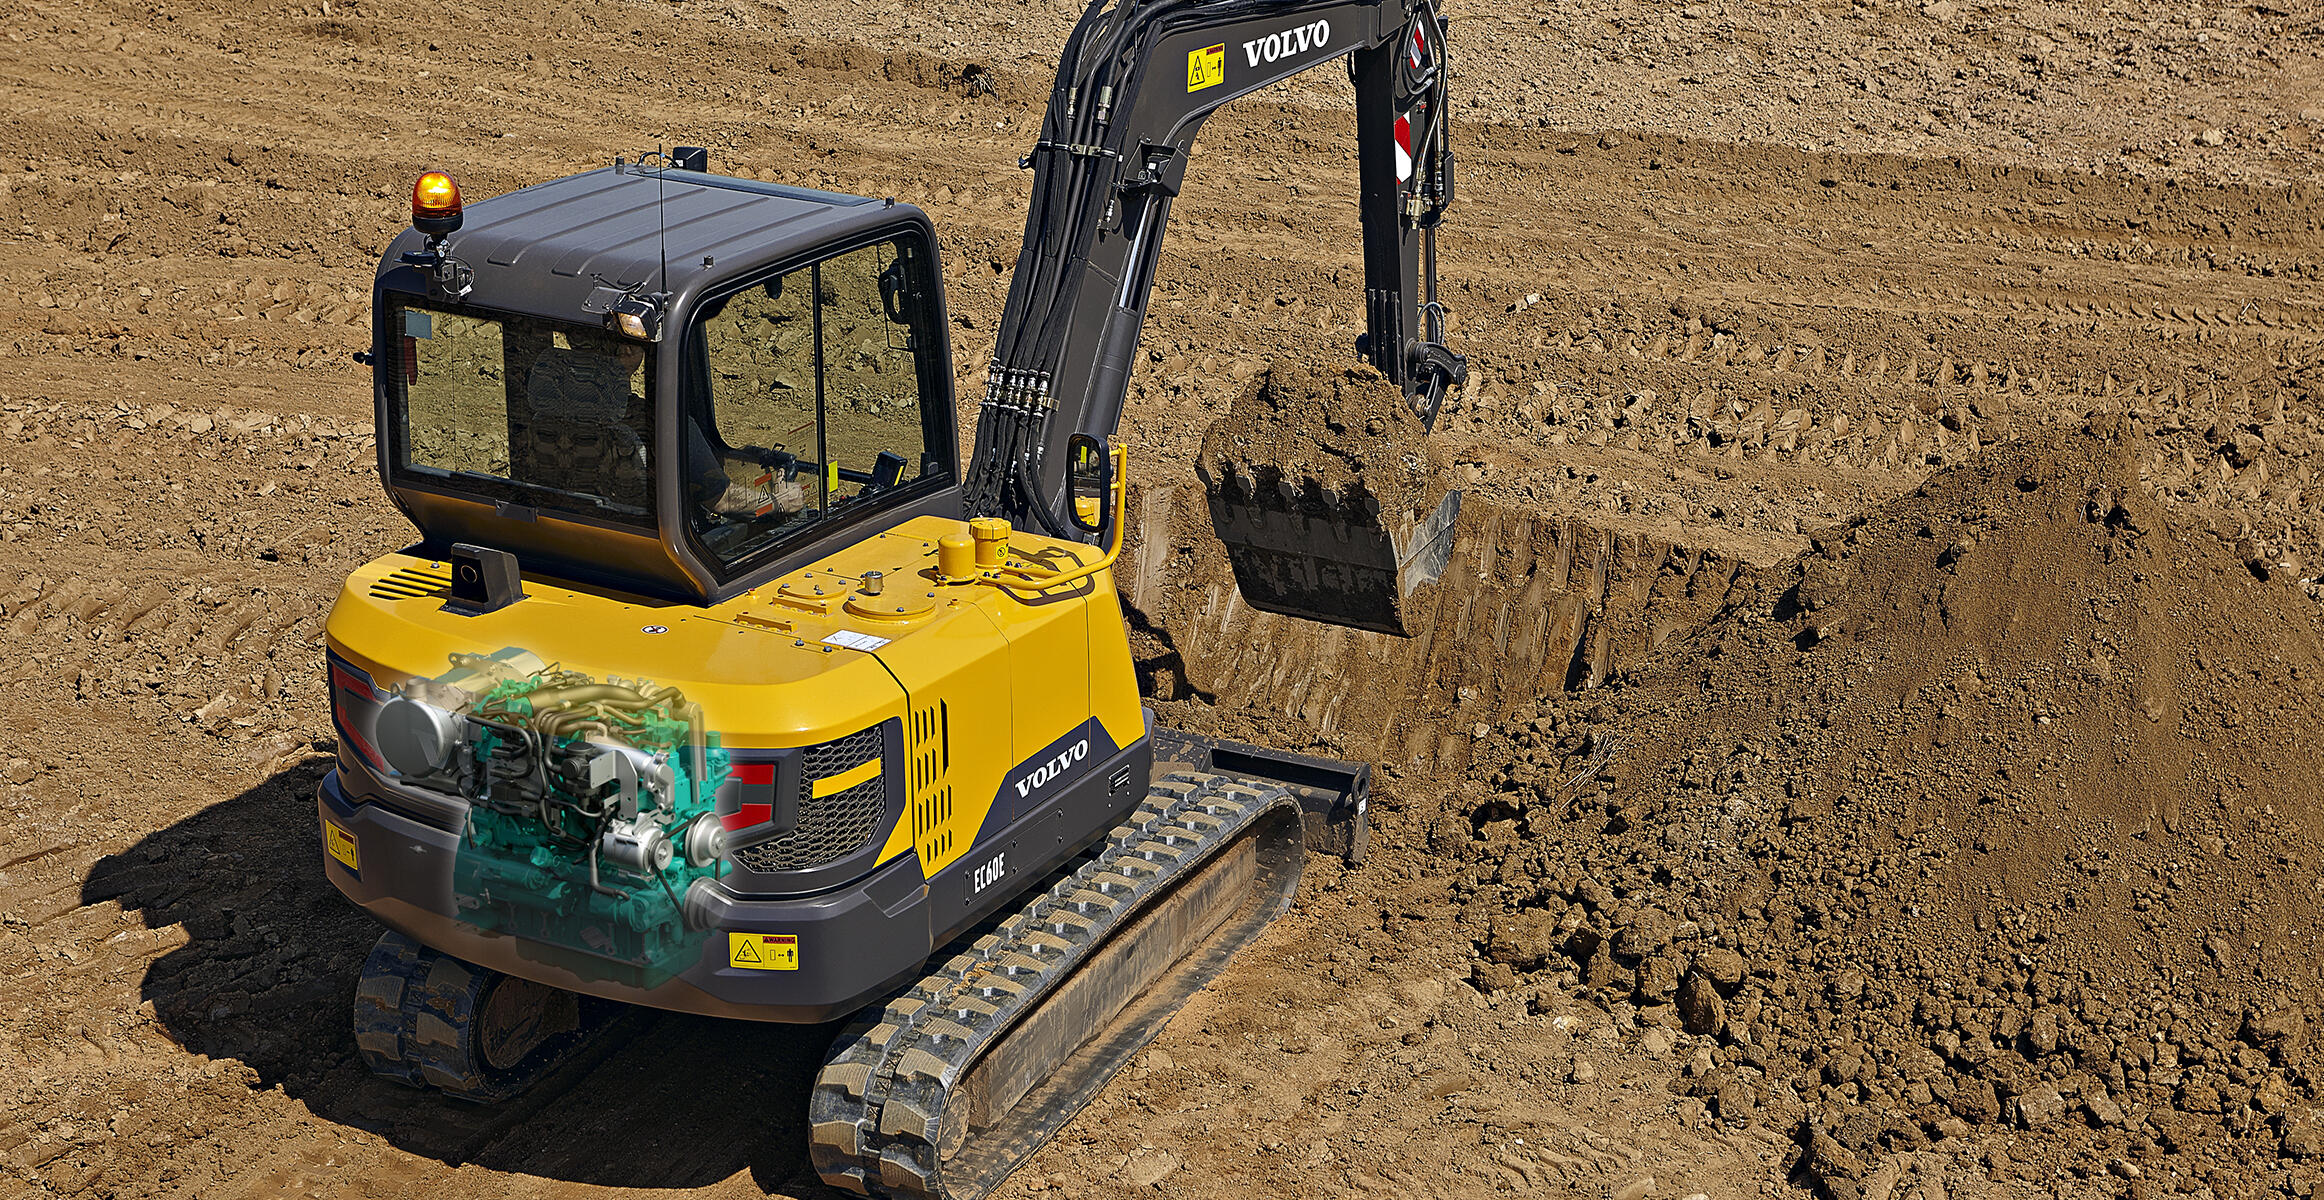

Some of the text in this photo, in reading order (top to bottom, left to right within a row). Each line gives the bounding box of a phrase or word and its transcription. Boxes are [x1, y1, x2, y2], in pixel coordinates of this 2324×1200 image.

[1243, 19, 1330, 67] VOLVO
[1015, 739, 1088, 798] VOLVO
[974, 852, 1005, 894] EC60E
